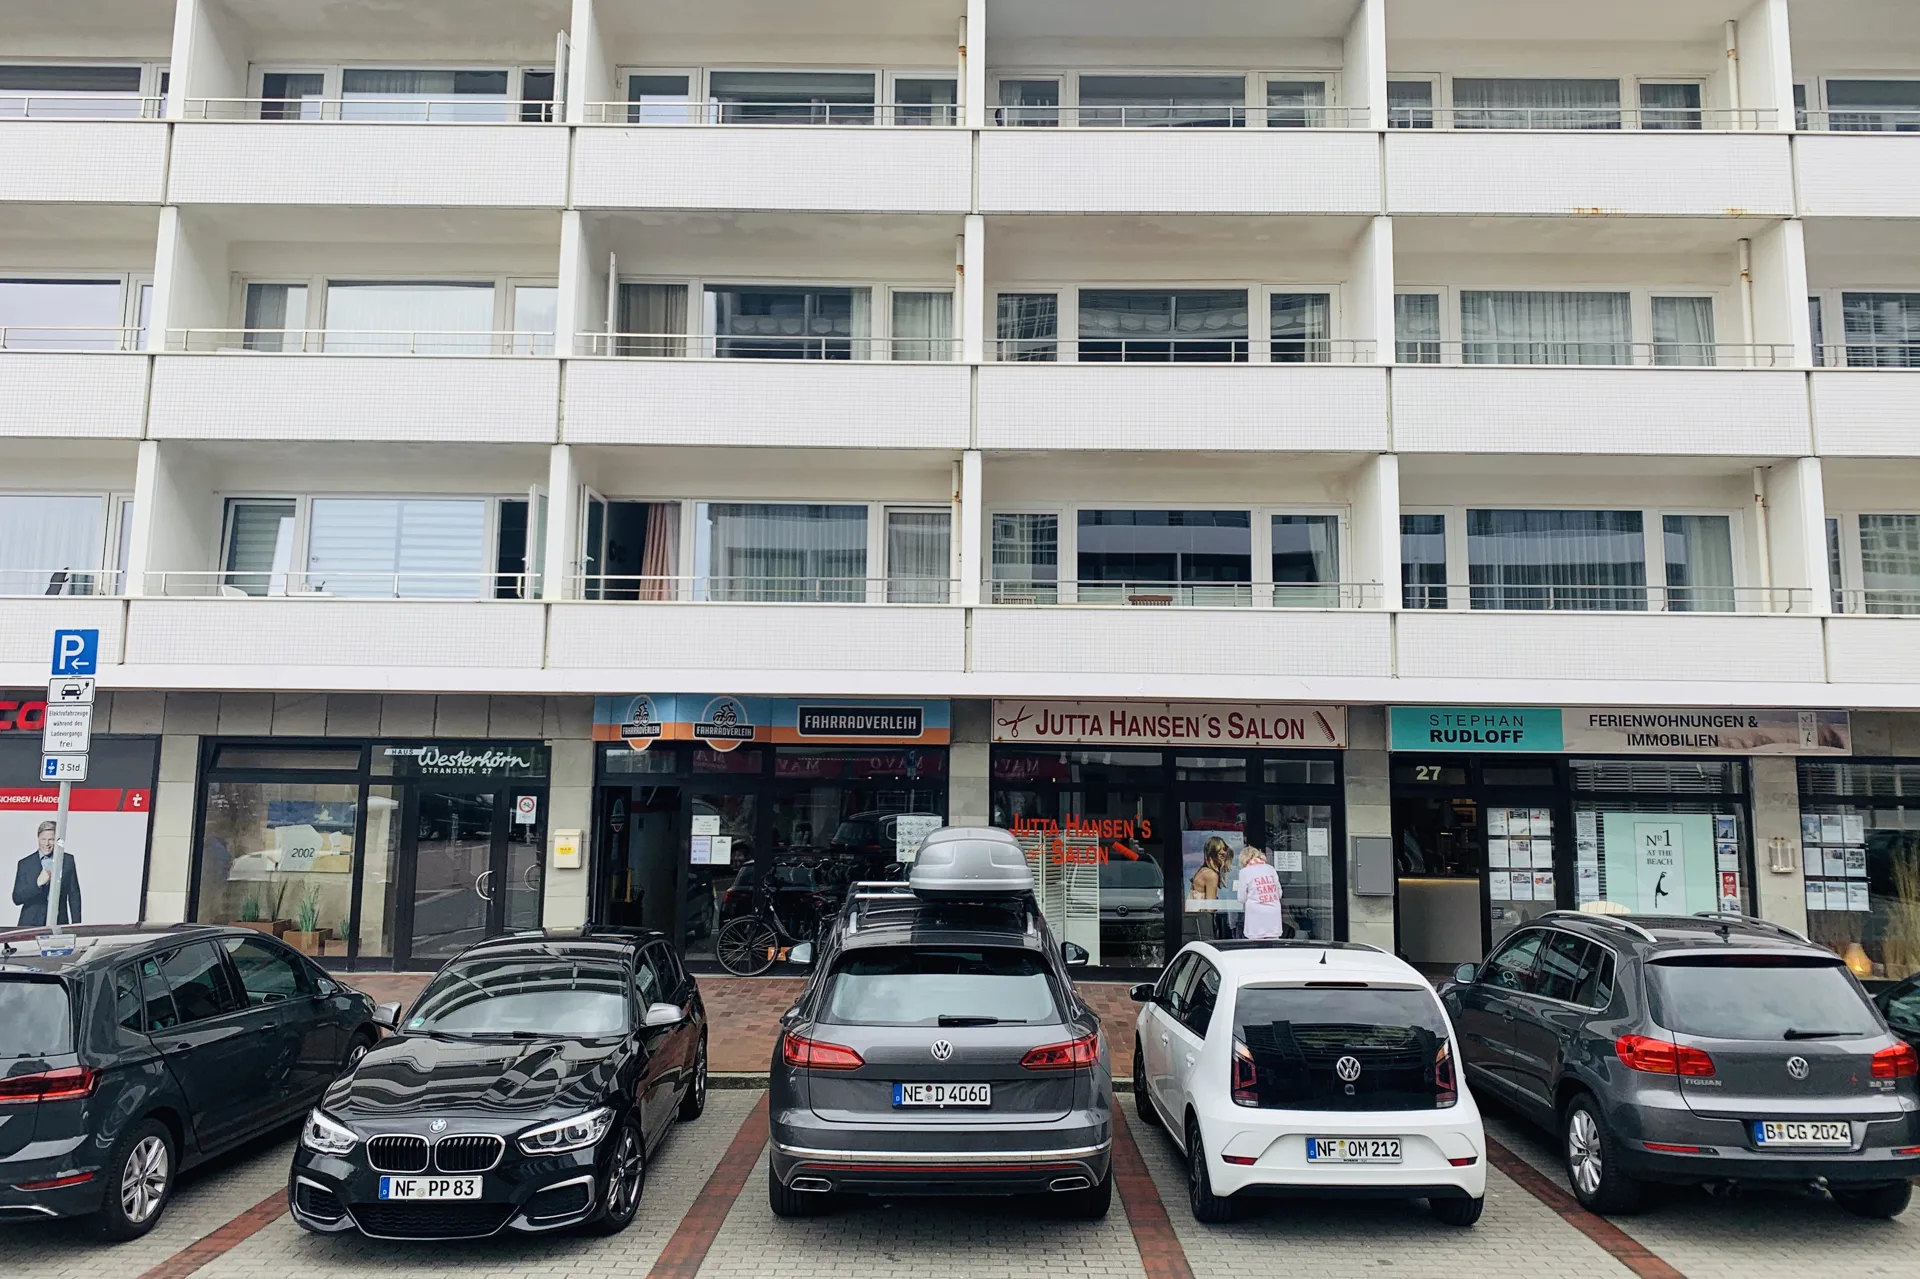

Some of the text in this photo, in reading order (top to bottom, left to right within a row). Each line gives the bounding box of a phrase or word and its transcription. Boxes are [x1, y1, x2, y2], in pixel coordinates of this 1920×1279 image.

[59, 635, 85, 669] P
[804, 715, 917, 730] FAHRRADVERLEIH
[1035, 709, 1103, 736] JUTTA
[1228, 711, 1305, 740] SALON
[1429, 714, 1524, 727] STEPHAN
[1589, 714, 1759, 728] FERIENWOHNUNGEN &
[622, 725, 660, 735] FAHRRADVERLEIH
[696, 726, 752, 736] FAHRRADVERLEIH
[1429, 729, 1524, 743] RUDLOFF
[60, 740, 72, 748] frei
[1627, 733, 1719, 747] IMMOBILIEN
[418, 746, 531, 768] Westerhörn
[60, 763, 82, 772] 3 Std.
[1415, 765, 1442, 781] 27
[0, 794, 60, 804] ICHEREN HÄNDE
[1008, 812, 1059, 837] JUTTA
[291, 847, 315, 858] 2002
[1051, 839, 1109, 865] SALON
[1647, 858, 1673, 866] BEACH
[1254, 875, 1275, 886] SALT
[1685, 1078, 1722, 1087] TIGUAN
[903, 1086, 923, 1102] NE
[935, 1087, 945, 1102] D
[949, 1086, 988, 1102] 4060
[1765, 1124, 1776, 1139] B
[1787, 1125, 1807, 1139] CG
[1811, 1125, 1848, 1140] 2024
[1317, 1141, 1336, 1157] NF
[1348, 1141, 1368, 1157] OM
[1372, 1141, 1400, 1157] 212
[395, 1180, 417, 1197] NF
[429, 1180, 450, 1197] PP
[453, 1180, 475, 1196] 83
